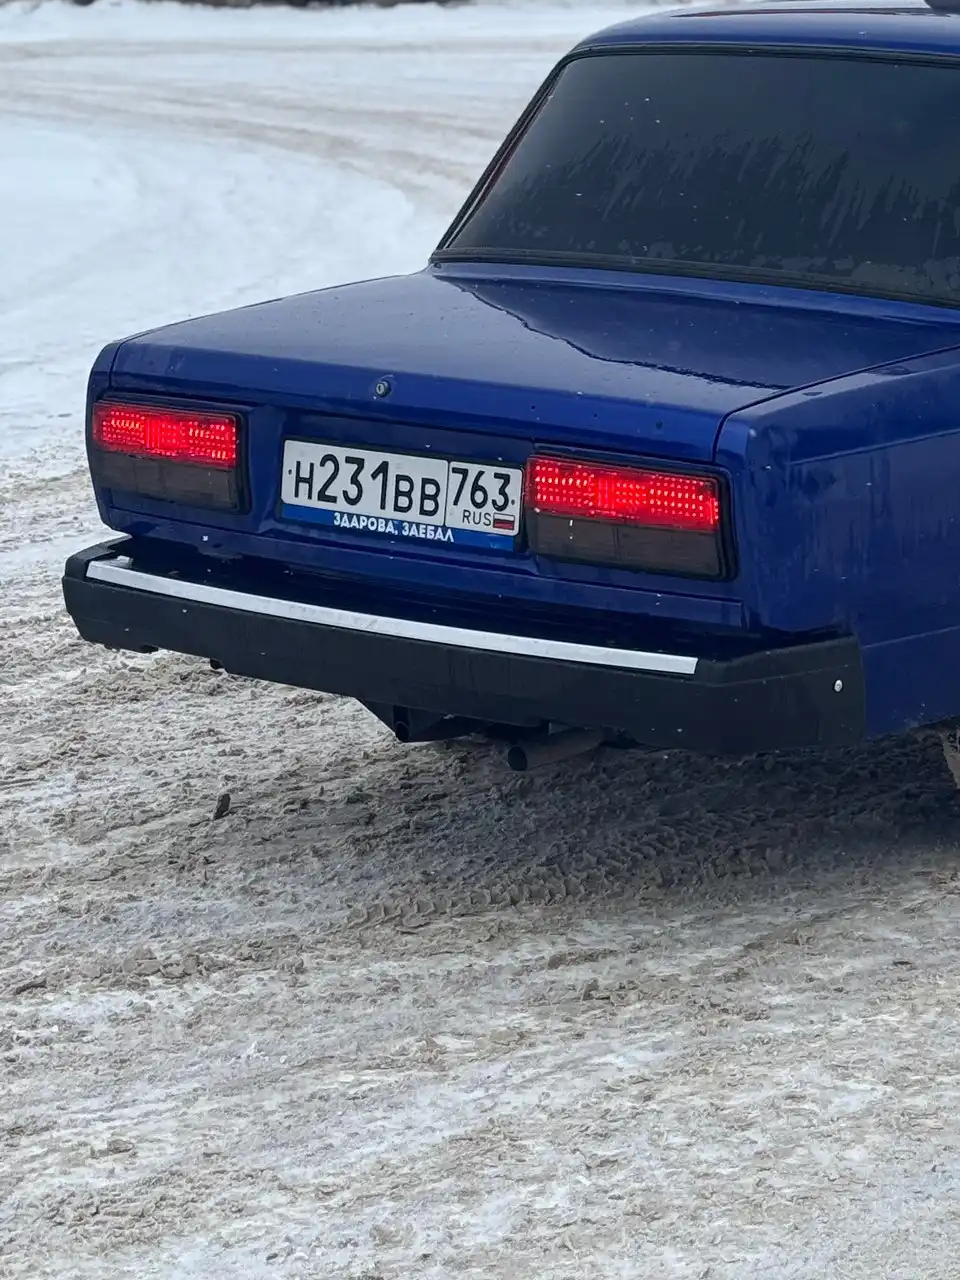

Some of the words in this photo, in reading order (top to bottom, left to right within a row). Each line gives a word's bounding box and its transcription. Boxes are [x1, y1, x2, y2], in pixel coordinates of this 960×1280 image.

[452, 467, 511, 512] 763
[334, 512, 398, 536] ЗДАРОВА,
[402, 522, 454, 542] ЗАЕБАЛ
[462, 509, 492, 527] RUS
